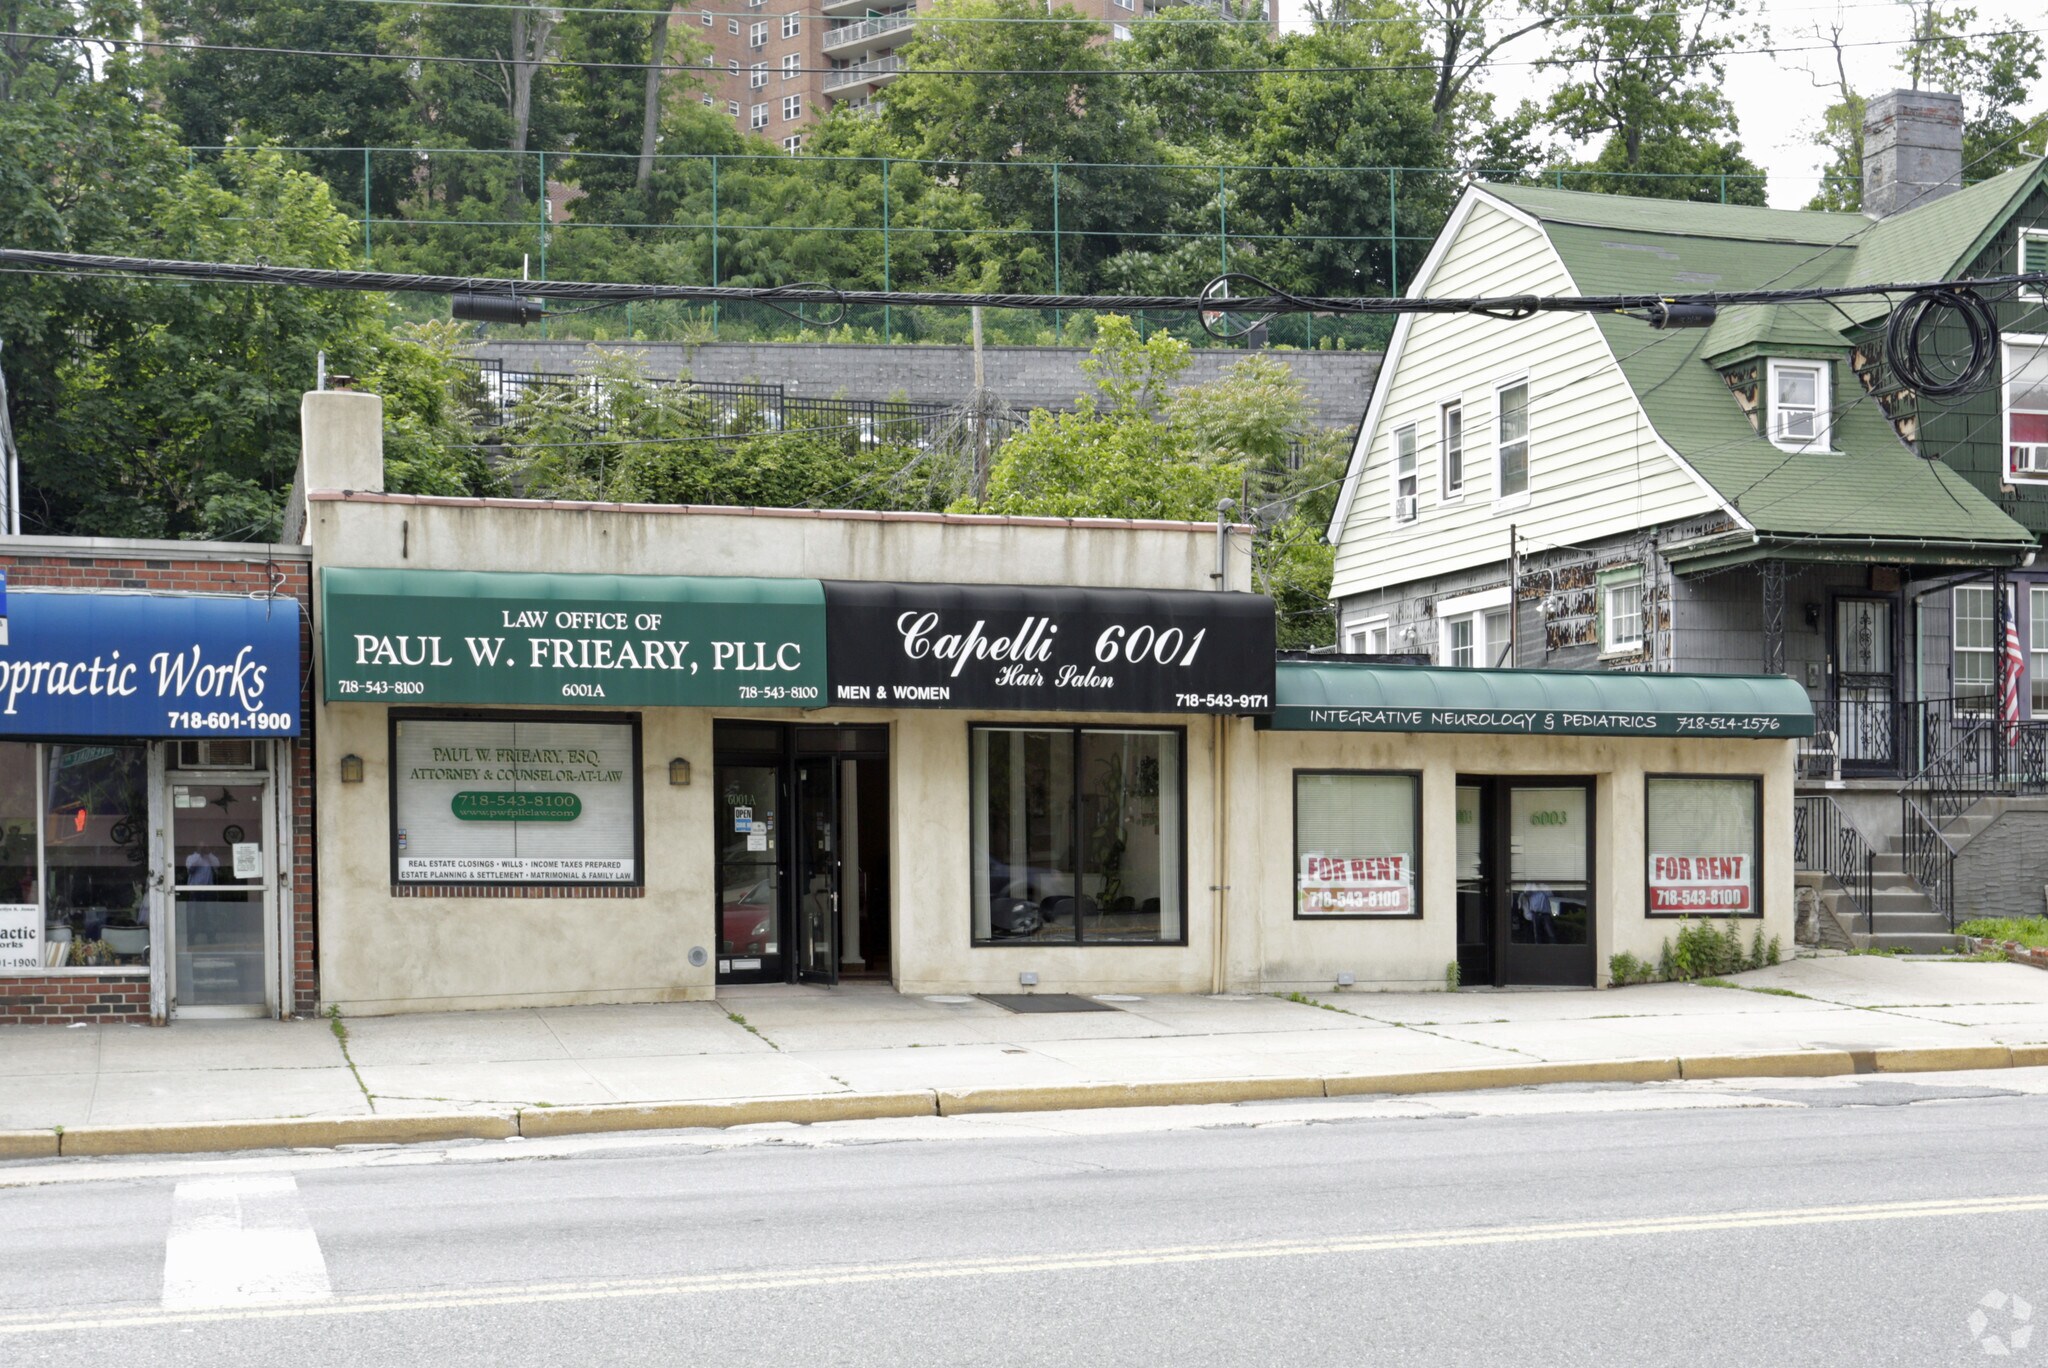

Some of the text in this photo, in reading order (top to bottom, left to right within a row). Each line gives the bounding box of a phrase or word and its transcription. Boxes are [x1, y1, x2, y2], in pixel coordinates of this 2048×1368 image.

[503, 610, 662, 631] LAW OFFICE OF
[897, 611, 1206, 677] Capelli 6001
[354, 634, 801, 674] PAUL W. FRIEARY, PLLC
[149, 644, 267, 713] Works
[995, 665, 1115, 689] Hair Salon
[338, 679, 424, 695] 718-543-8100
[562, 683, 605, 698] 6001A
[739, 685, 818, 699] 718-543-8100
[837, 685, 950, 701] MEN & WOMEN
[1175, 693, 1268, 708] 718-543-9171
[168, 711, 291, 730] 718-601-1900
[1310, 710, 1780, 733] INTEGRATIVE NEUROLOGY & PEDIATRICS 718-514-1576
[433, 747, 600, 767] PAUL W. FRIEARY, ESQ.
[410, 768, 623, 782] ATTORNEY & COUNSELOR-AT-LAW
[459, 795, 574, 807] 718-543-8100
[728, 794, 756, 806] 6001A
[459, 808, 574, 818] www.pwfpllclaw.com
[735, 809, 751, 818] OPEN
[1530, 810, 1567, 826] 6003
[408, 860, 427, 868] REAL
[429, 860, 455, 868] ESTATE
[458, 860, 495, 868] CLOSINGS
[1308, 857, 1403, 881] FOR RENT
[1656, 856, 1743, 880] FOR RENT
[401, 871, 428, 879] ESTATE
[430, 871, 467, 879] PLANNING
[589, 872, 613, 880] FAMILY
[1309, 890, 1400, 907] 718-543-8100
[1656, 889, 1741, 906] 718-543-8100
[0, 926, 36, 939] actic
[0, 958, 37, 967] 1-1900
